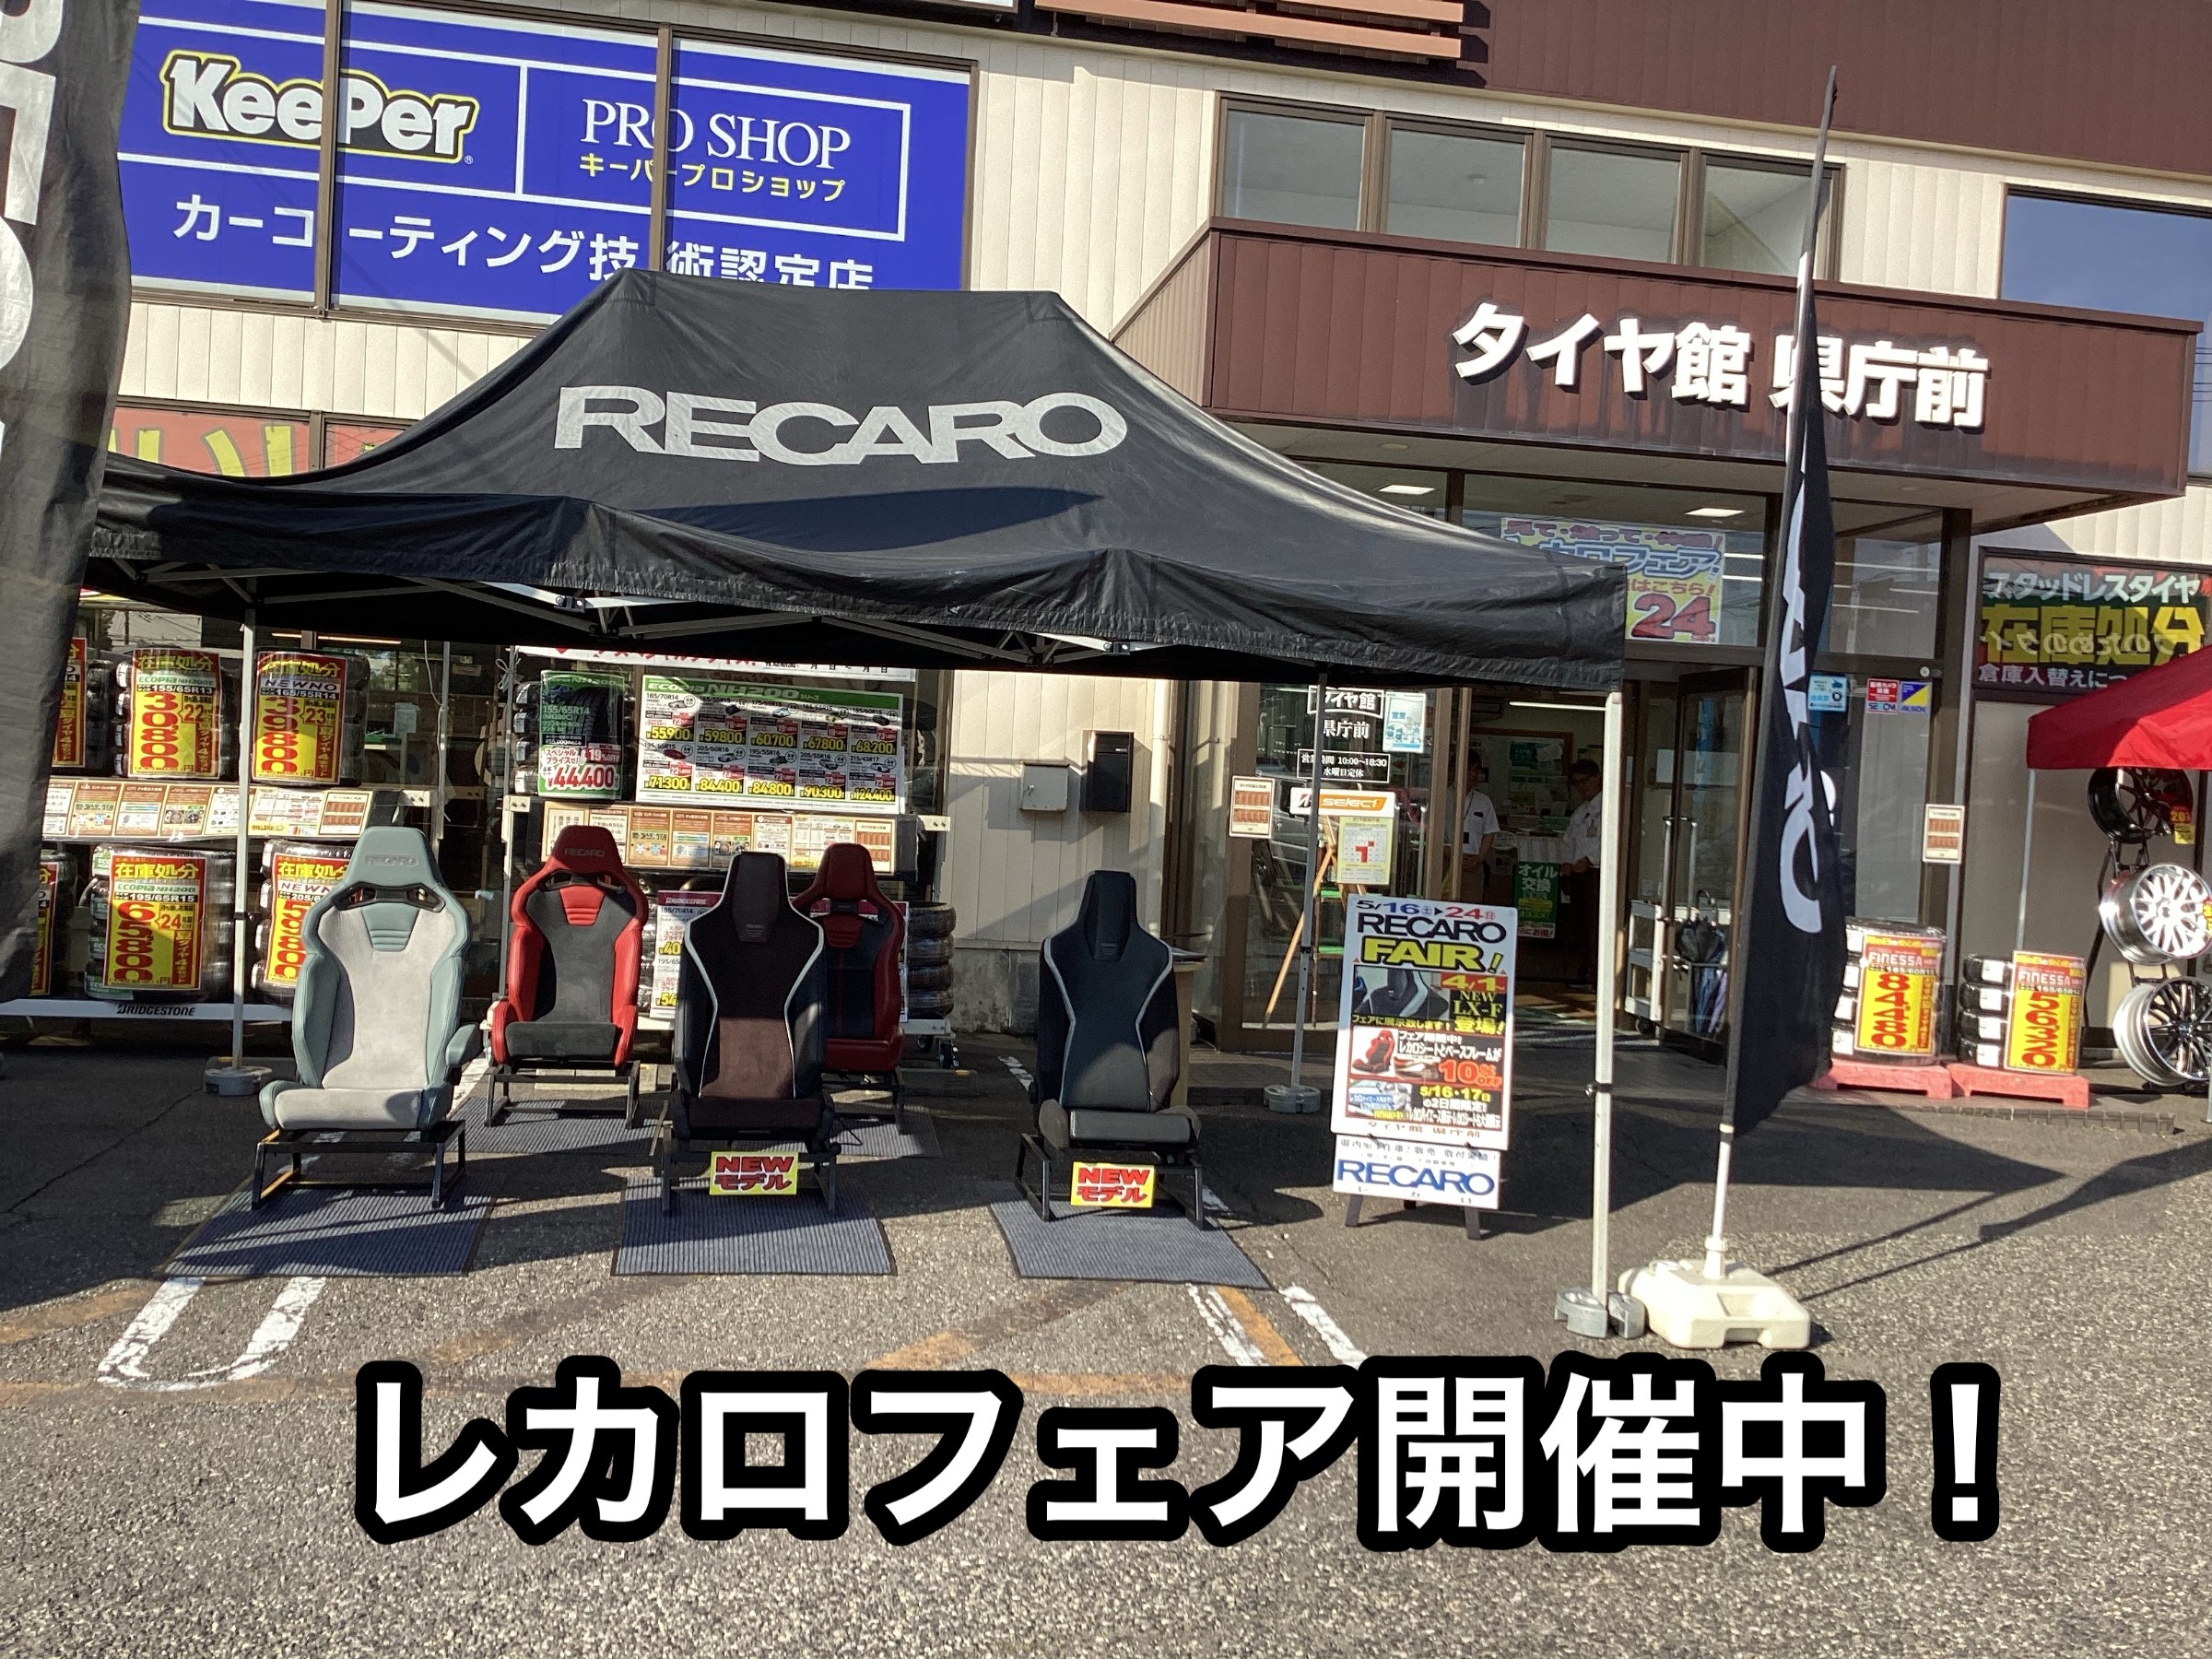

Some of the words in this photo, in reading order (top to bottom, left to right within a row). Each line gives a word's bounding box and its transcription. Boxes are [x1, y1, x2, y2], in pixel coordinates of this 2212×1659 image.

[166, 53, 472, 157] KeePer
[580, 99, 695, 152] PRO
[706, 113, 852, 170] SHOP
[1453, 302, 1751, 406] タイヤ館
[1769, 334, 1990, 428] 県庁前
[554, 385, 1127, 466] RECARO
[1983, 572, 2201, 604] スタッドレスタイヤ
[1630, 594, 1717, 639] 24
[1982, 604, 2205, 666] 在庫処分
[265, 679, 337, 691] NEWNO
[707, 684, 798, 698] NH200
[543, 706, 590, 714] 155/65R14
[1324, 719, 1370, 738] 県庁前
[1323, 768, 1364, 777] 水曜日定休
[365, 855, 418, 865] RECARO
[115, 863, 199, 879] 在庫処分
[281, 882, 333, 893] NEWN
[130, 893, 194, 902] 195/65R15
[292, 893, 323, 902] 205/6
[1357, 912, 1507, 944] RECARO
[1867, 952, 1924, 967] FINESSA
[2018, 971, 2071, 985] FINESSA
[1459, 991, 1496, 1002] NEW
[116, 1003, 196, 1017] BRIDGESTONE
[1453, 1000, 1503, 1018] LX-F
[1453, 1016, 1505, 1036] 登場!
[715, 1156, 794, 1173] NEW
[713, 1173, 793, 1192] モデル
[1077, 1167, 1148, 1185] NEW
[1336, 1159, 1495, 1196] RECARO
[1076, 1184, 1147, 1204] モデル
